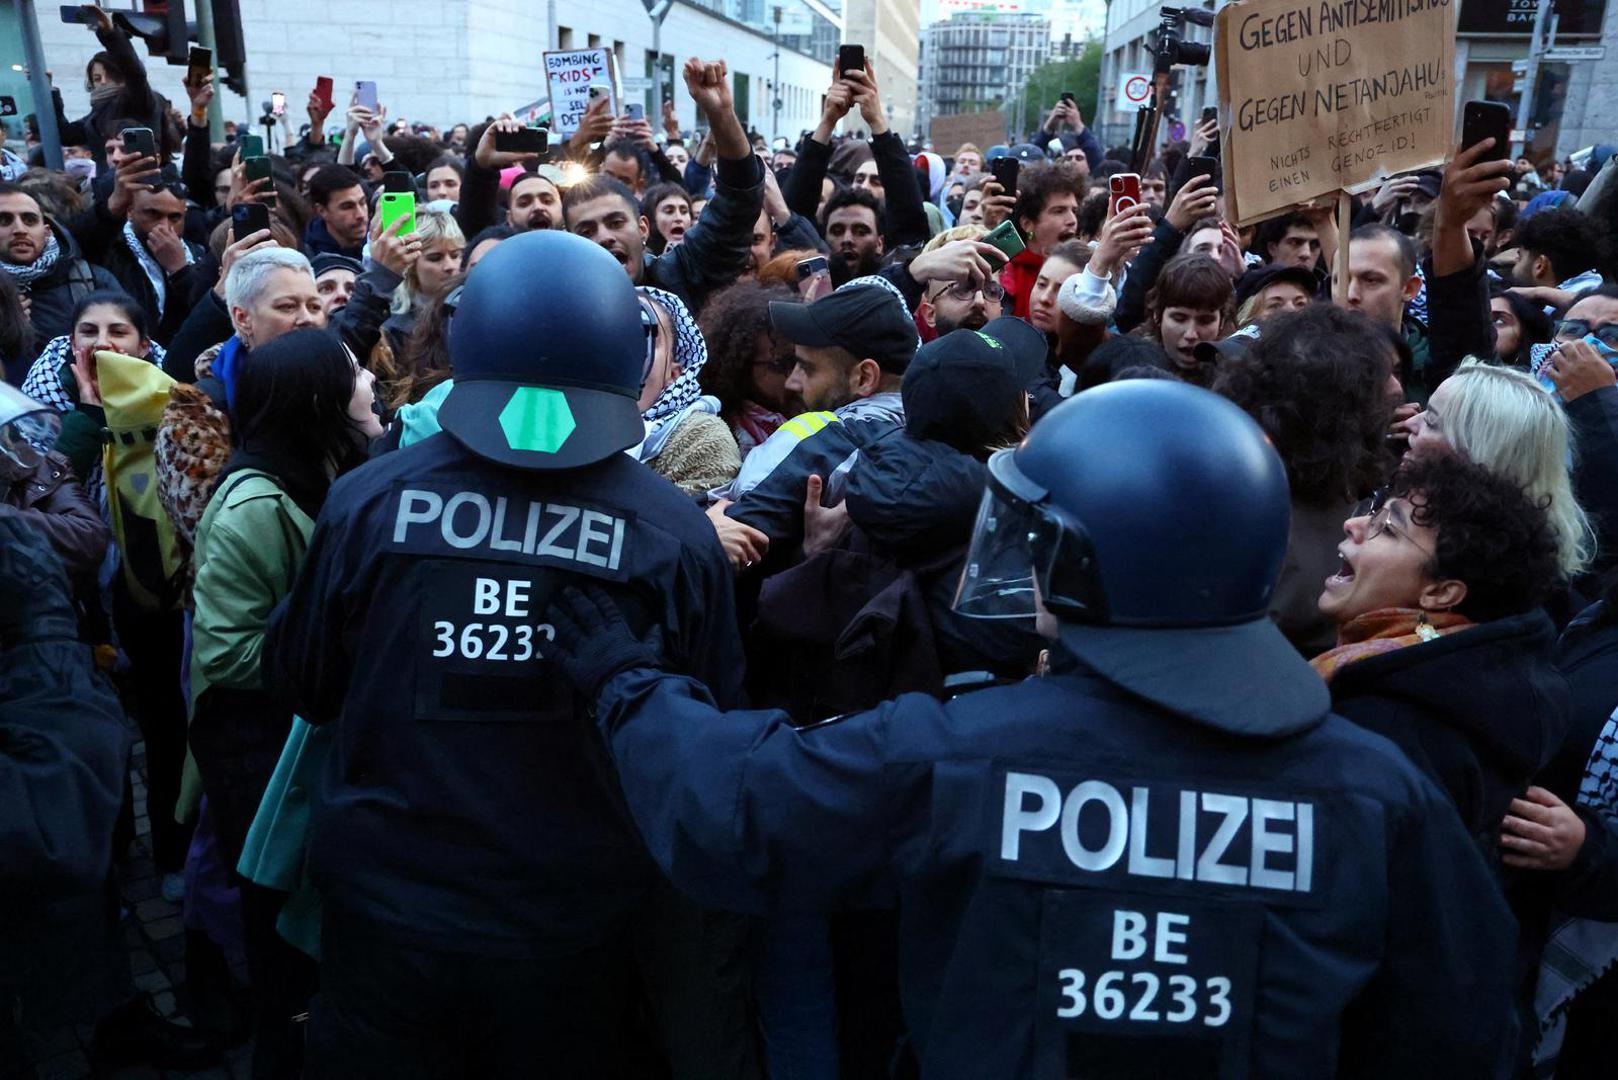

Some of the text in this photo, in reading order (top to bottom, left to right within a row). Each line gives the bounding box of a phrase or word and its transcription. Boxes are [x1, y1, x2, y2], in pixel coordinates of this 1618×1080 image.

[1239, 0, 1449, 51] GEGEN ANTISEMITIS
[548, 52, 601, 69] BOMBING
[559, 67, 592, 83] KIDS
[1299, 38, 1351, 78] UND
[1239, 92, 1306, 132] GEGEN
[1270, 107, 1431, 171] NICHTS RECHTFERTIGT
[1268, 169, 1311, 193] EINEN
[393, 489, 625, 570] POLIZEI
[474, 578, 531, 617] BE
[1001, 772, 1313, 892] POLIZEI
[1111, 910, 1190, 964] BE
[1057, 968, 1232, 1027] 36233
